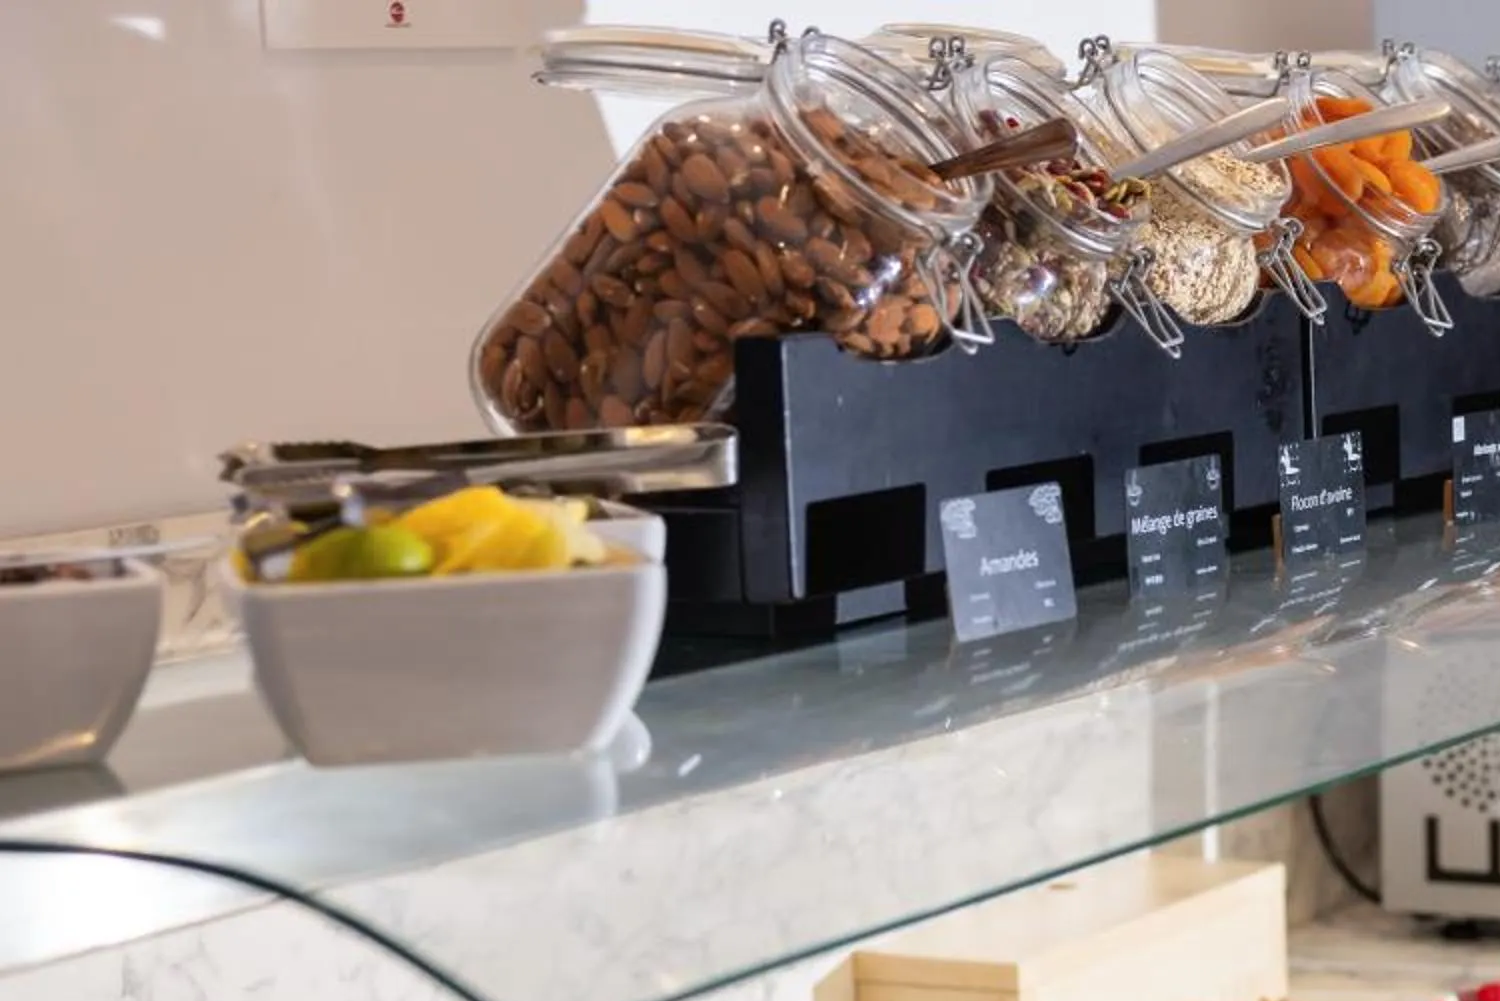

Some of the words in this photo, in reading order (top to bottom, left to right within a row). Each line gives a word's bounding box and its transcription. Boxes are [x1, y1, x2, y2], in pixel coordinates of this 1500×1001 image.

[1131, 514, 1172, 535] Mélange
[1173, 508, 1185, 527] de
[1186, 506, 1218, 529] graines
[980, 549, 1039, 576] Amandes
